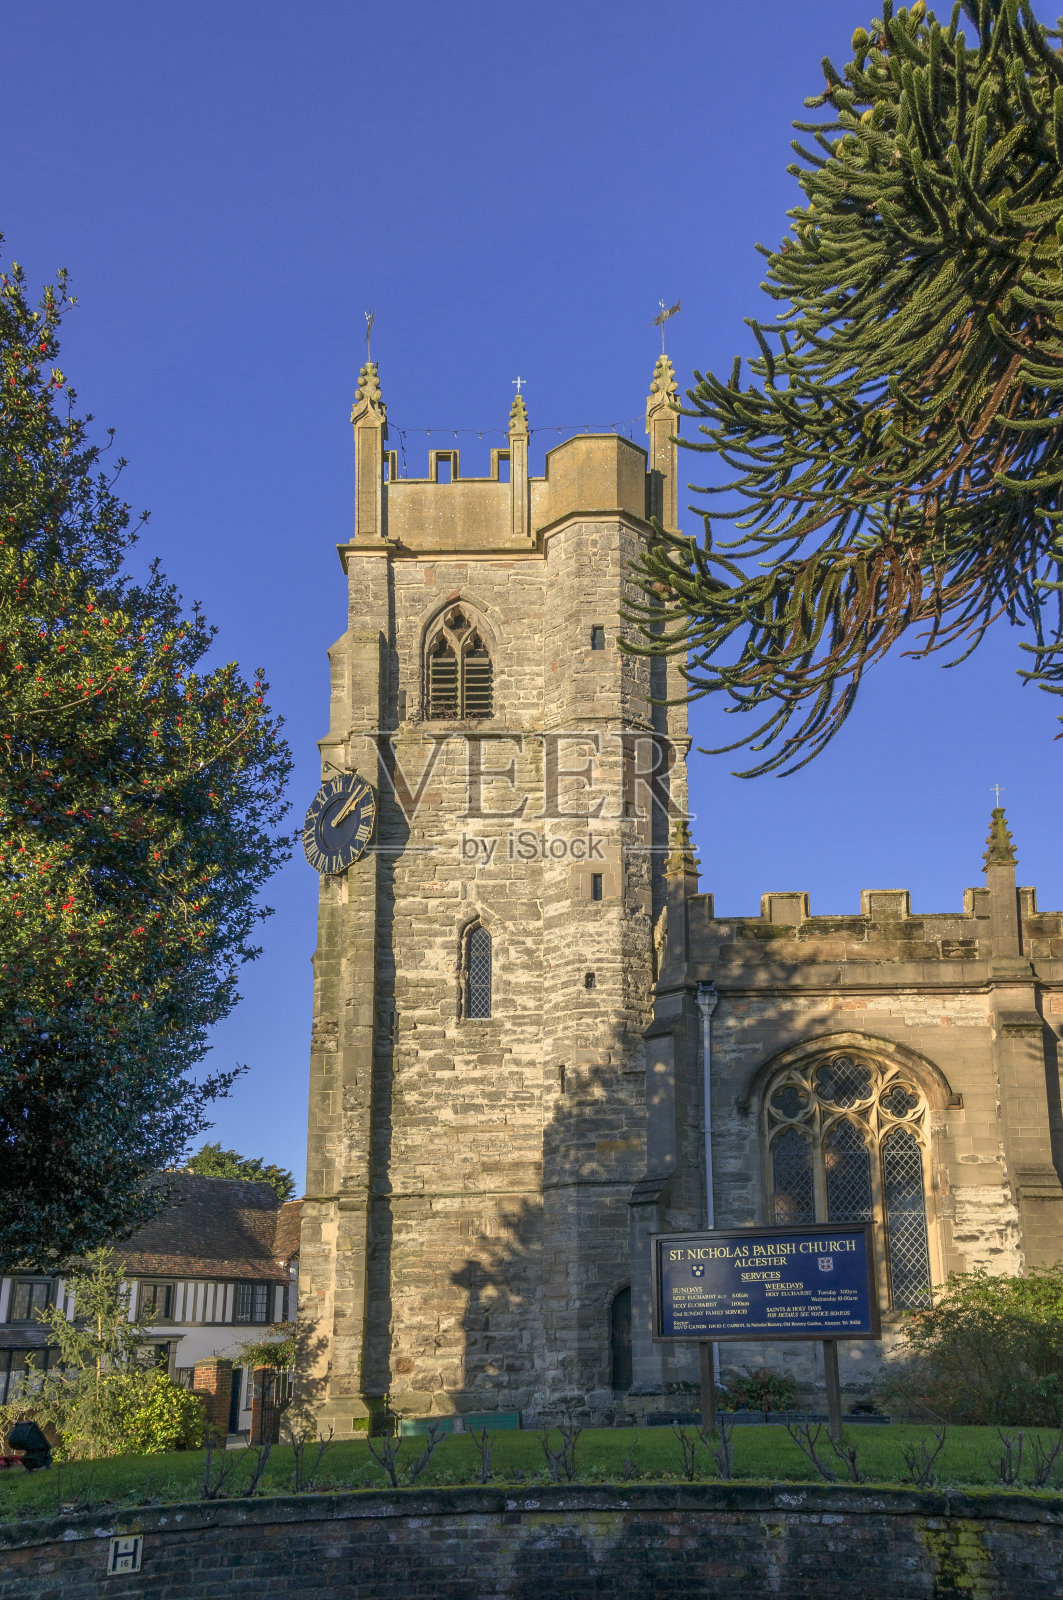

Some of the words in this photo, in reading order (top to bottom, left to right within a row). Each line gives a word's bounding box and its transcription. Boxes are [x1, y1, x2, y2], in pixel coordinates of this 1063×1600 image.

[669, 1250, 684, 1261] ST.
[687, 1246, 749, 1260] NICHOLAS
[753, 1243, 796, 1256] PARISH
[799, 1240, 856, 1254] CHURCH
[734, 1257, 787, 1268] ALCESTER
[741, 1271, 781, 1280] SERVICES
[672, 1286, 703, 1294] SUNDAYS
[112, 1538, 138, 1571] H
